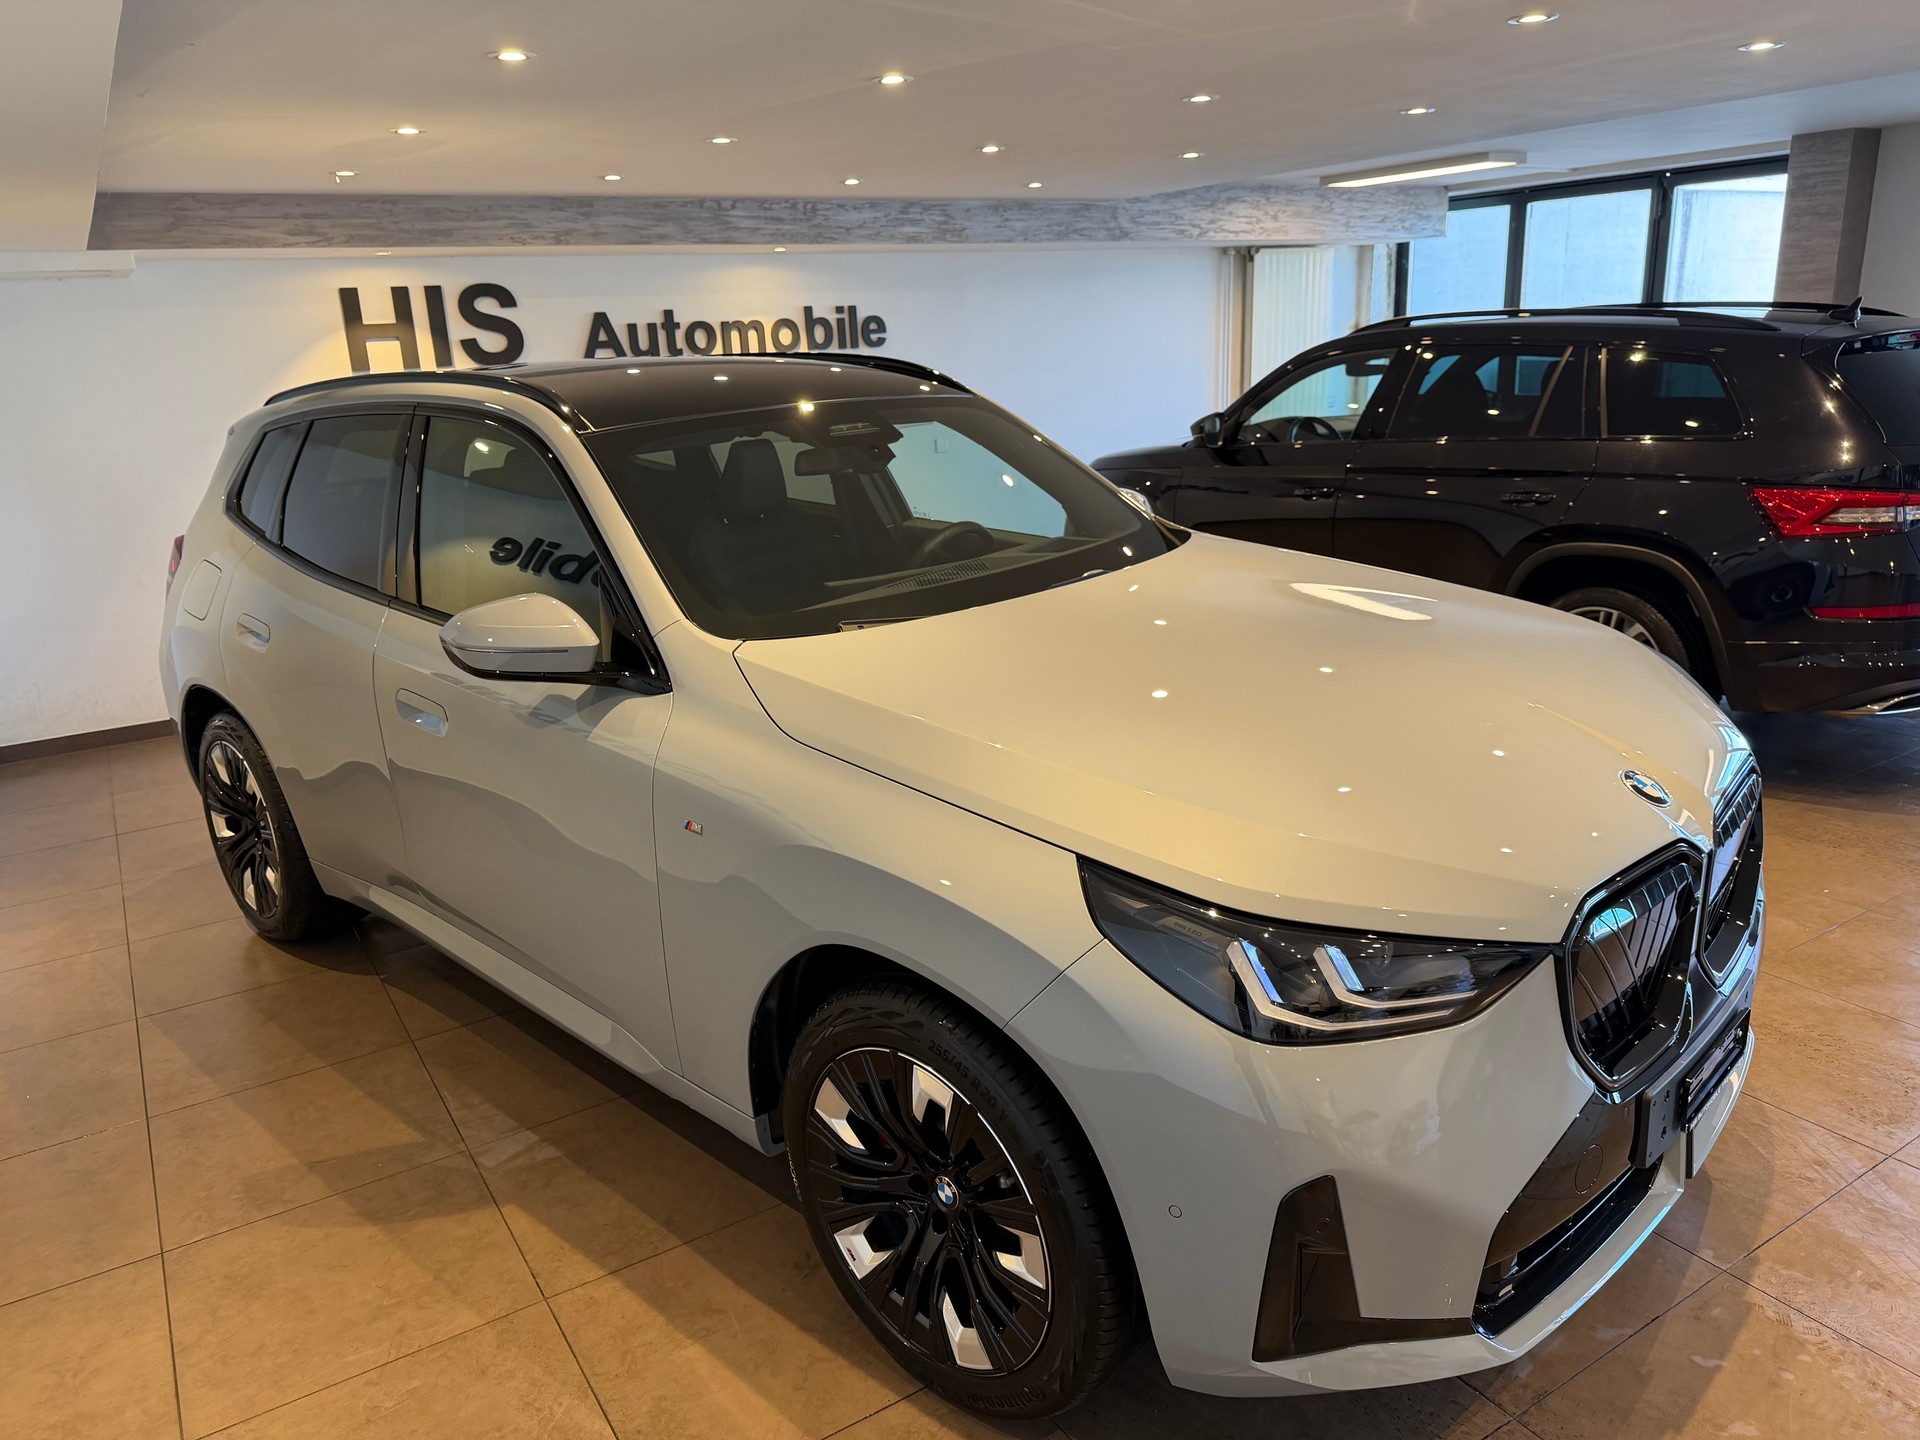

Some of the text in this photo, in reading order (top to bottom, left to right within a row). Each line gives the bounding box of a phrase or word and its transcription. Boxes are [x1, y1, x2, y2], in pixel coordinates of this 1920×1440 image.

[338, 282, 888, 373] HIS Automobile
[927, 1039, 971, 1080] 255/45
[964, 1384, 1046, 1411] Continental
